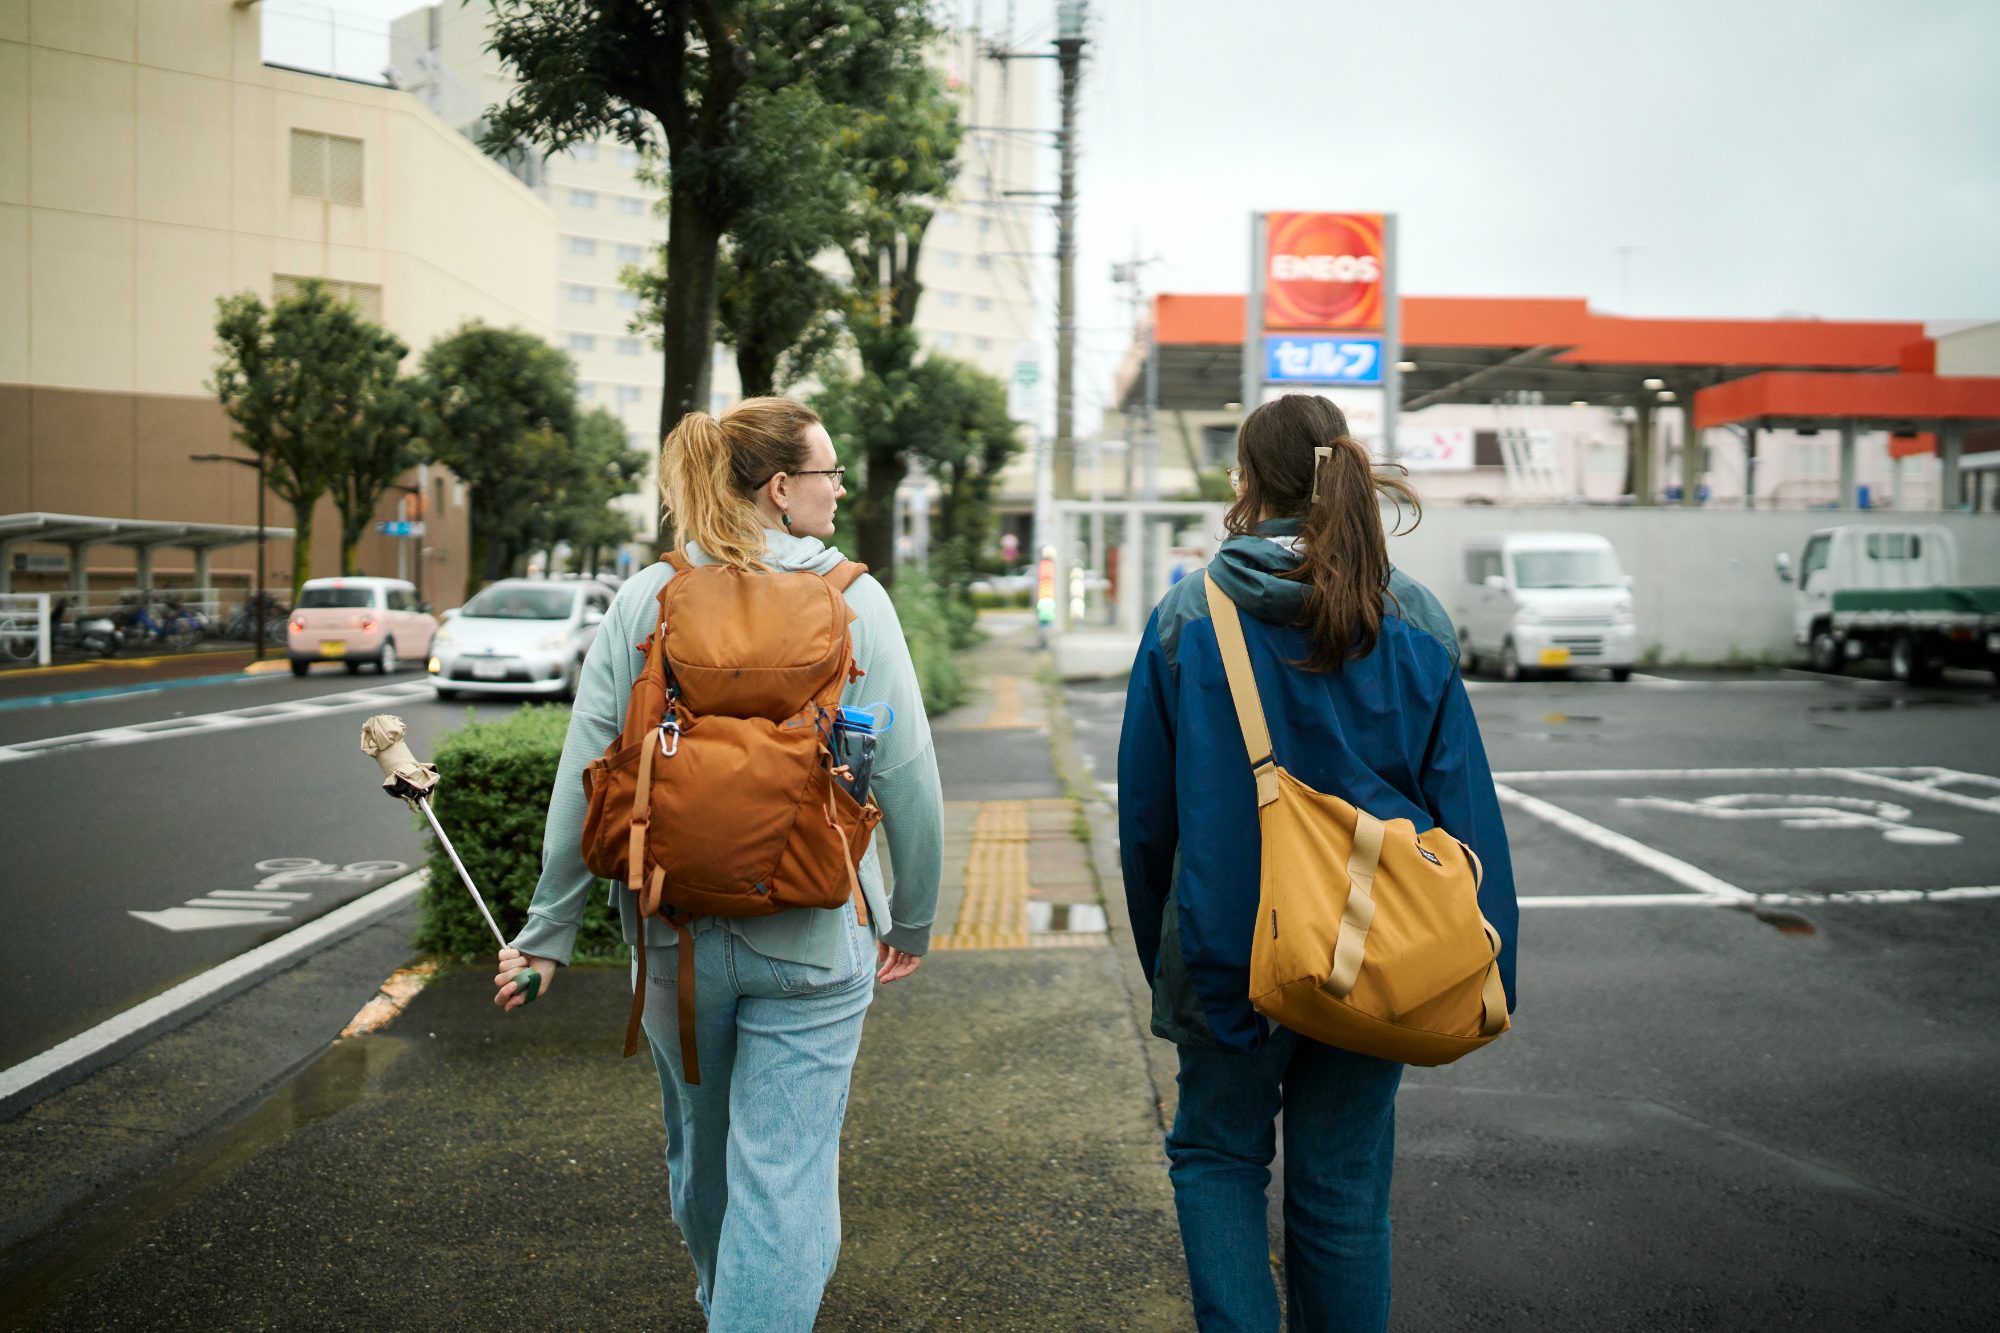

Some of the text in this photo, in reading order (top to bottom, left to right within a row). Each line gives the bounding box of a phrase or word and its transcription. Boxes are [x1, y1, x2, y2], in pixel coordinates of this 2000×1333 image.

[1271, 254, 1379, 282] ENEOS
[1273, 341, 1376, 377] セルフ
